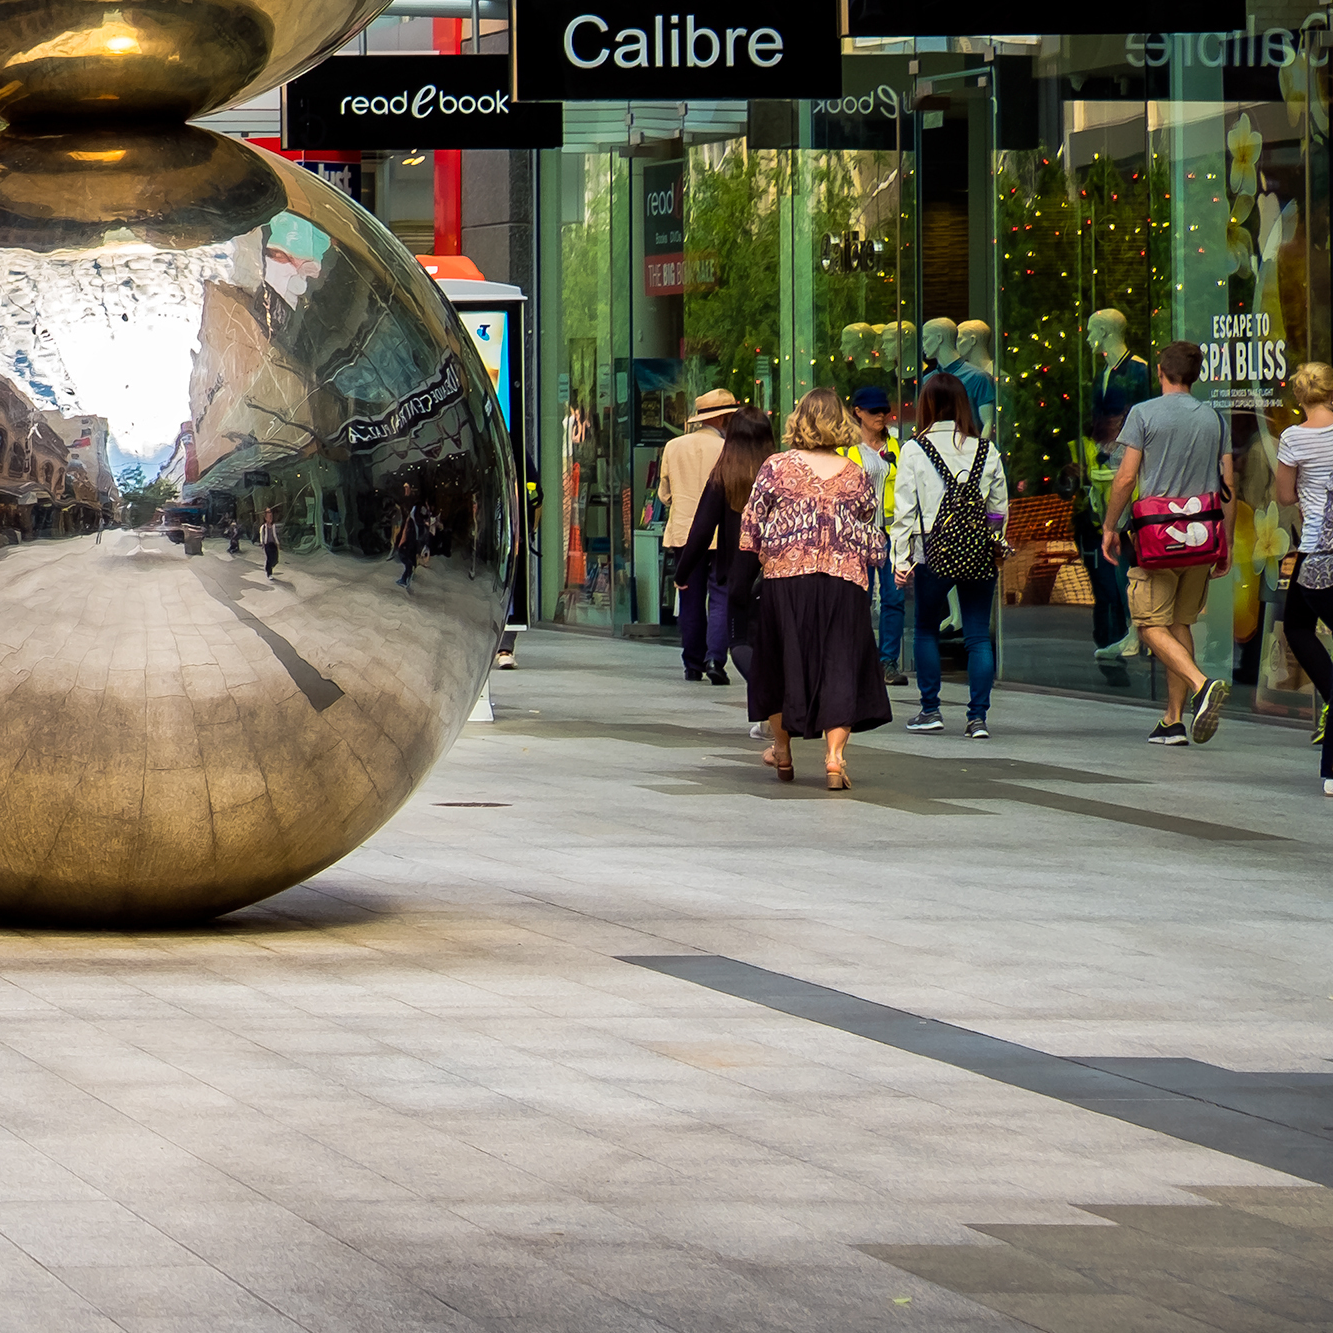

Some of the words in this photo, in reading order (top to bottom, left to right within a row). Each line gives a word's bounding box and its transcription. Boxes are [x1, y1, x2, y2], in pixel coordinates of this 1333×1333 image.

[563, 14, 784, 69] Calibre
[1213, 313, 1253, 339] ESCAPE
[1255, 312, 1270, 337] TO
[1199, 341, 1233, 382] SPA
[1235, 339, 1287, 381] BLISS
